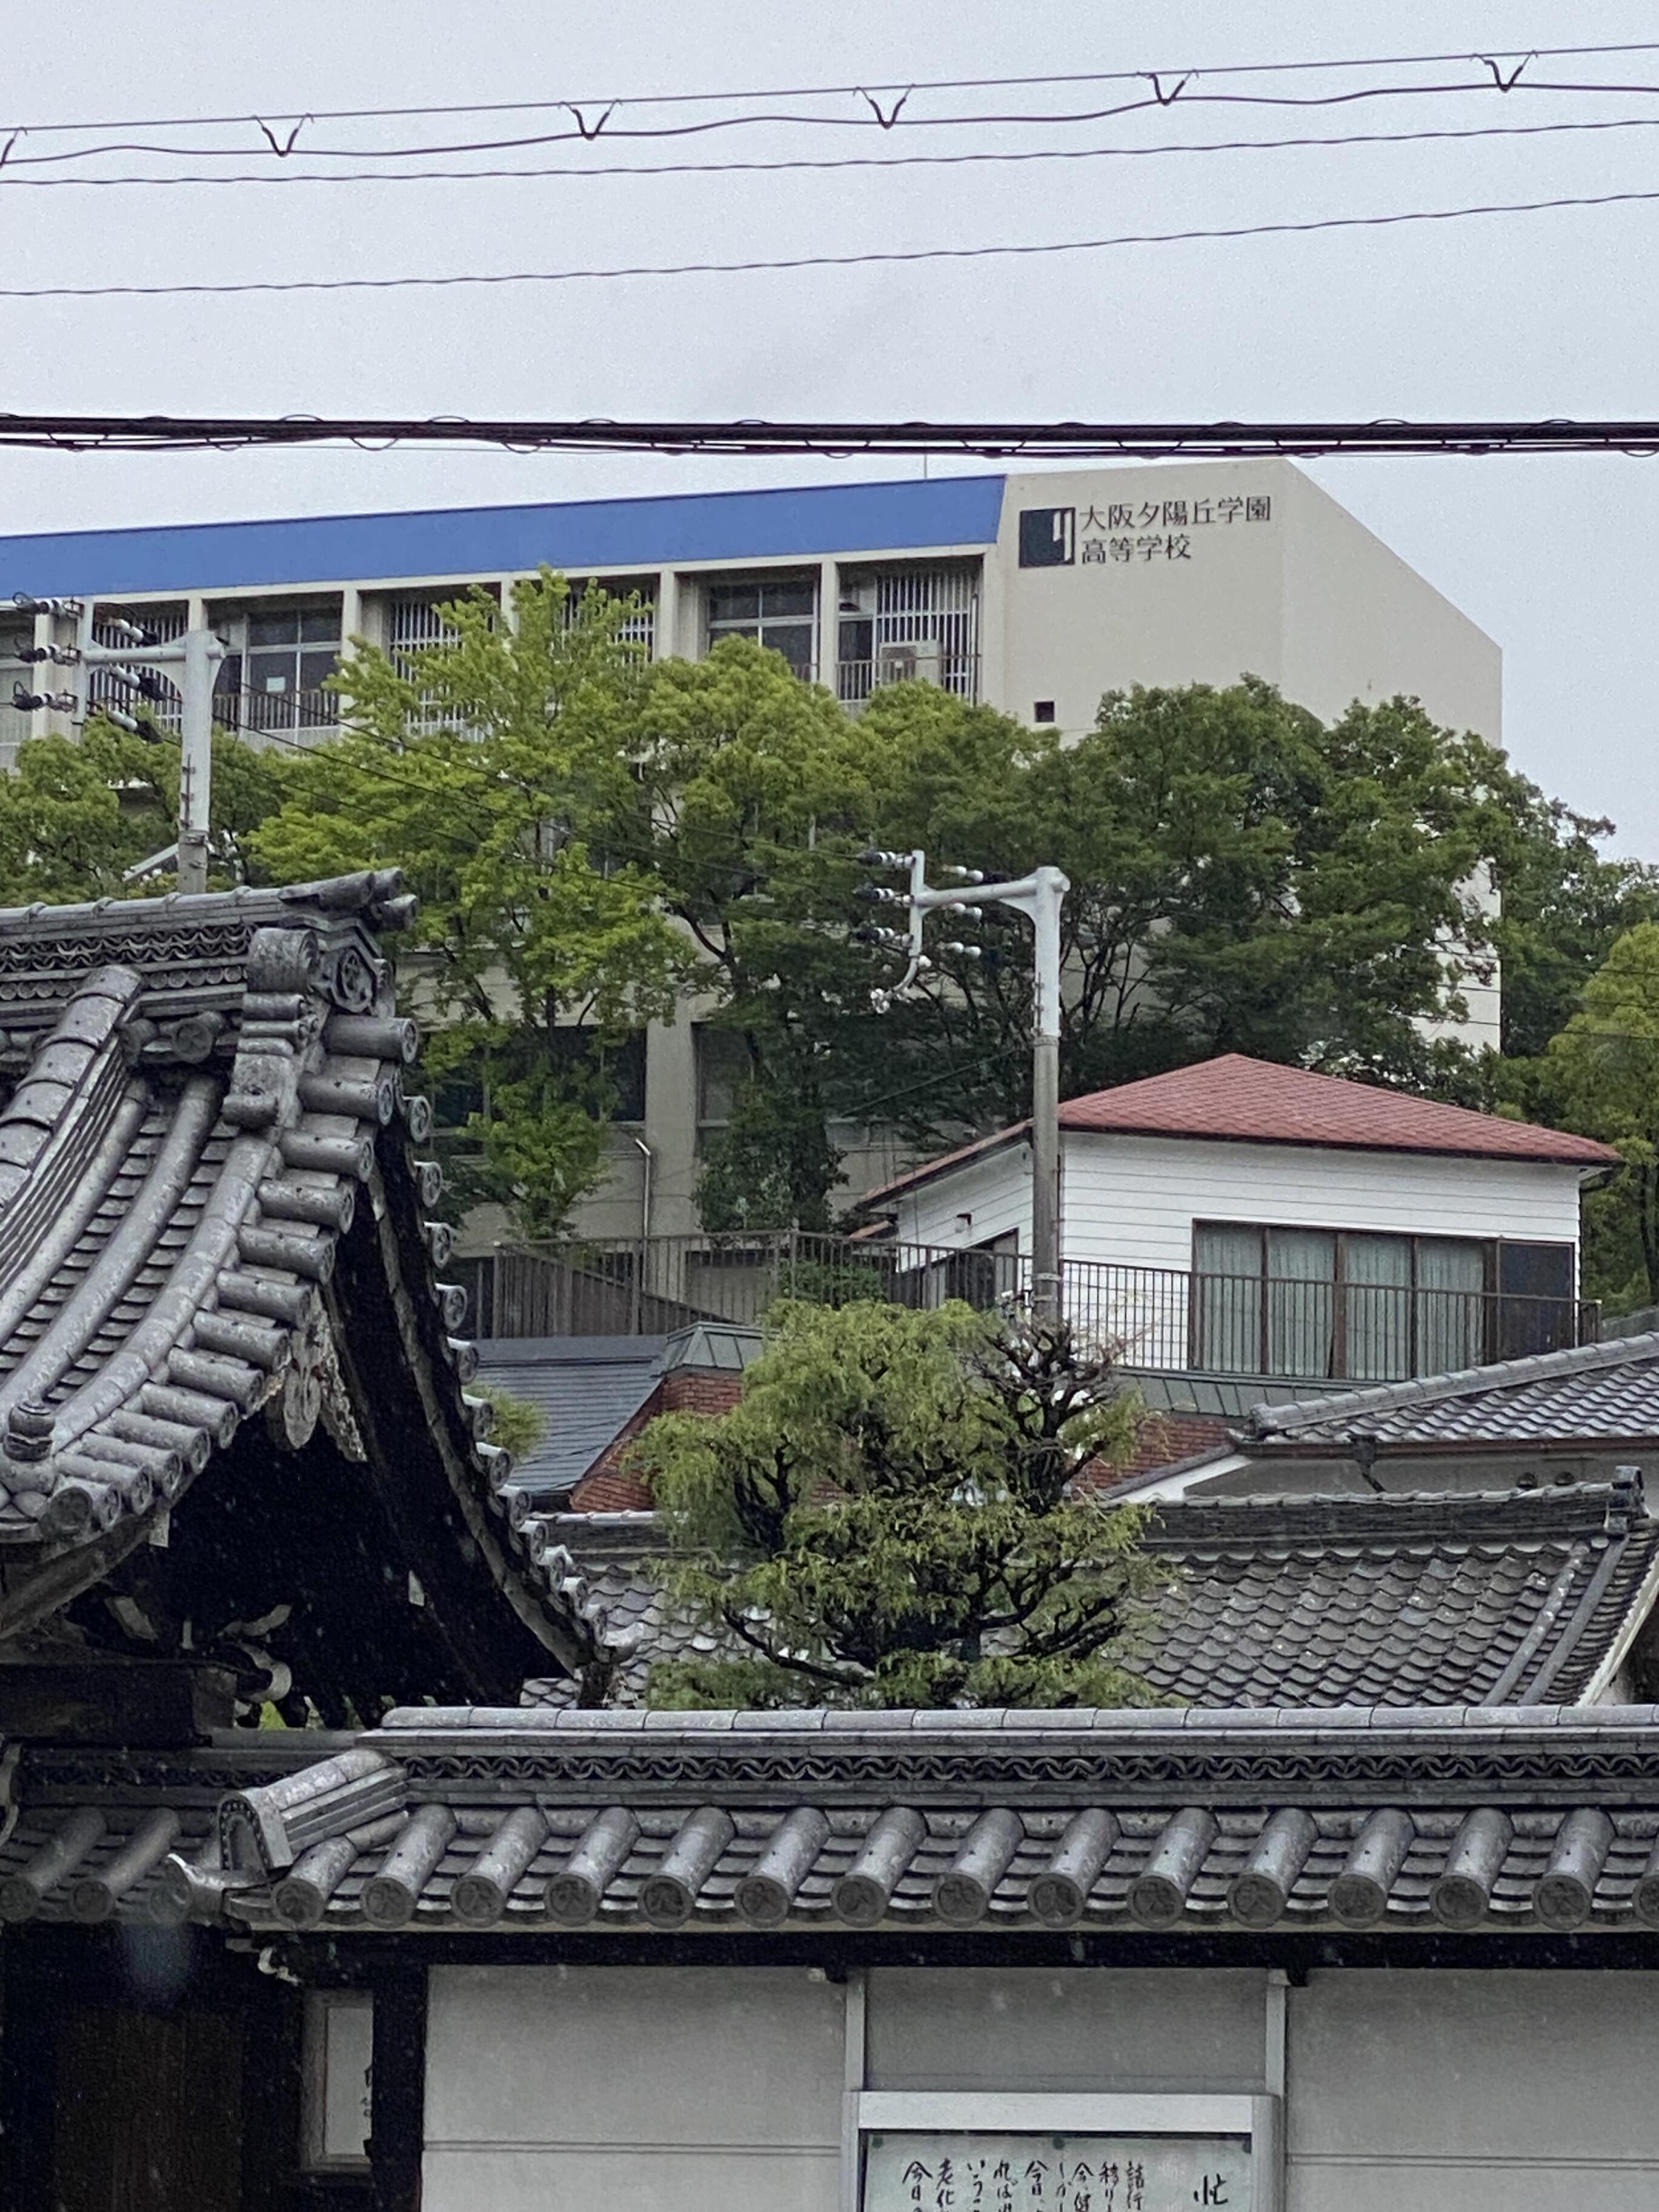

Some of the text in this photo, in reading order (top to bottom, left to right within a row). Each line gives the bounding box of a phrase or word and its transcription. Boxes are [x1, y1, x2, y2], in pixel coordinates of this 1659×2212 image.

[1080, 496, 1271, 531] 大阪夕陽丘学園
[1082, 533, 1191, 564] 高等学校
[936, 2158, 955, 2212] 老化
